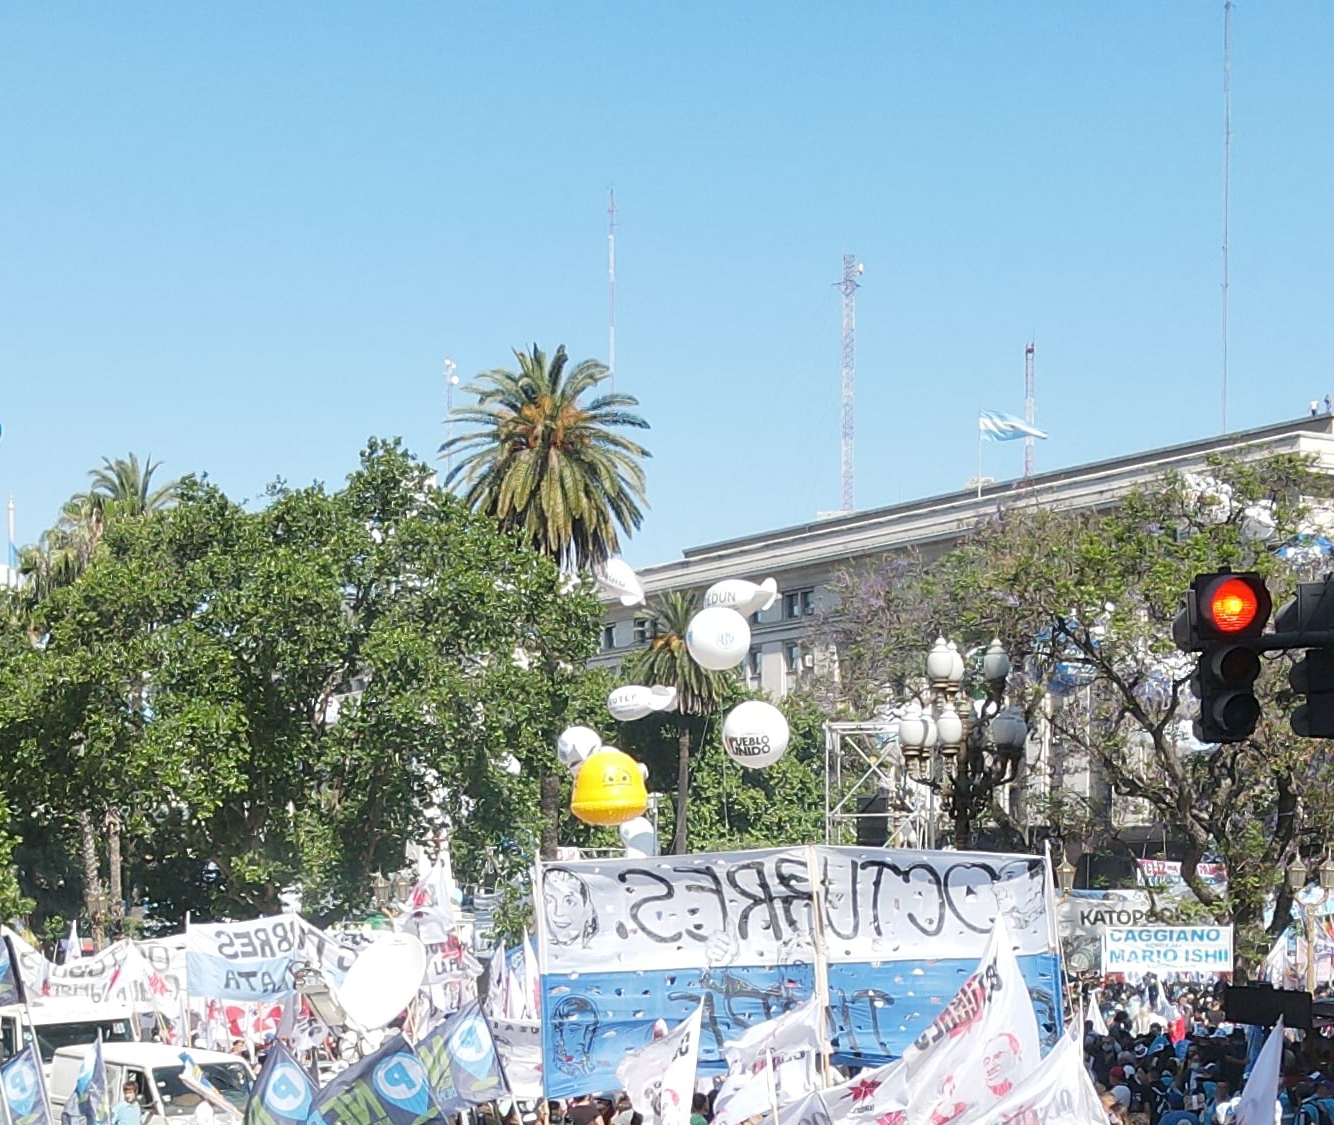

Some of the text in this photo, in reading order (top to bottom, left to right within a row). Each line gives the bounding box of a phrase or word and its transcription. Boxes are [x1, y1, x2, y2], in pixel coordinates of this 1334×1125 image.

[733, 745, 770, 756] UNIDO
[1110, 928, 1220, 943] CAGGIANO
[1110, 949, 1229, 963] MARIO ISHII
